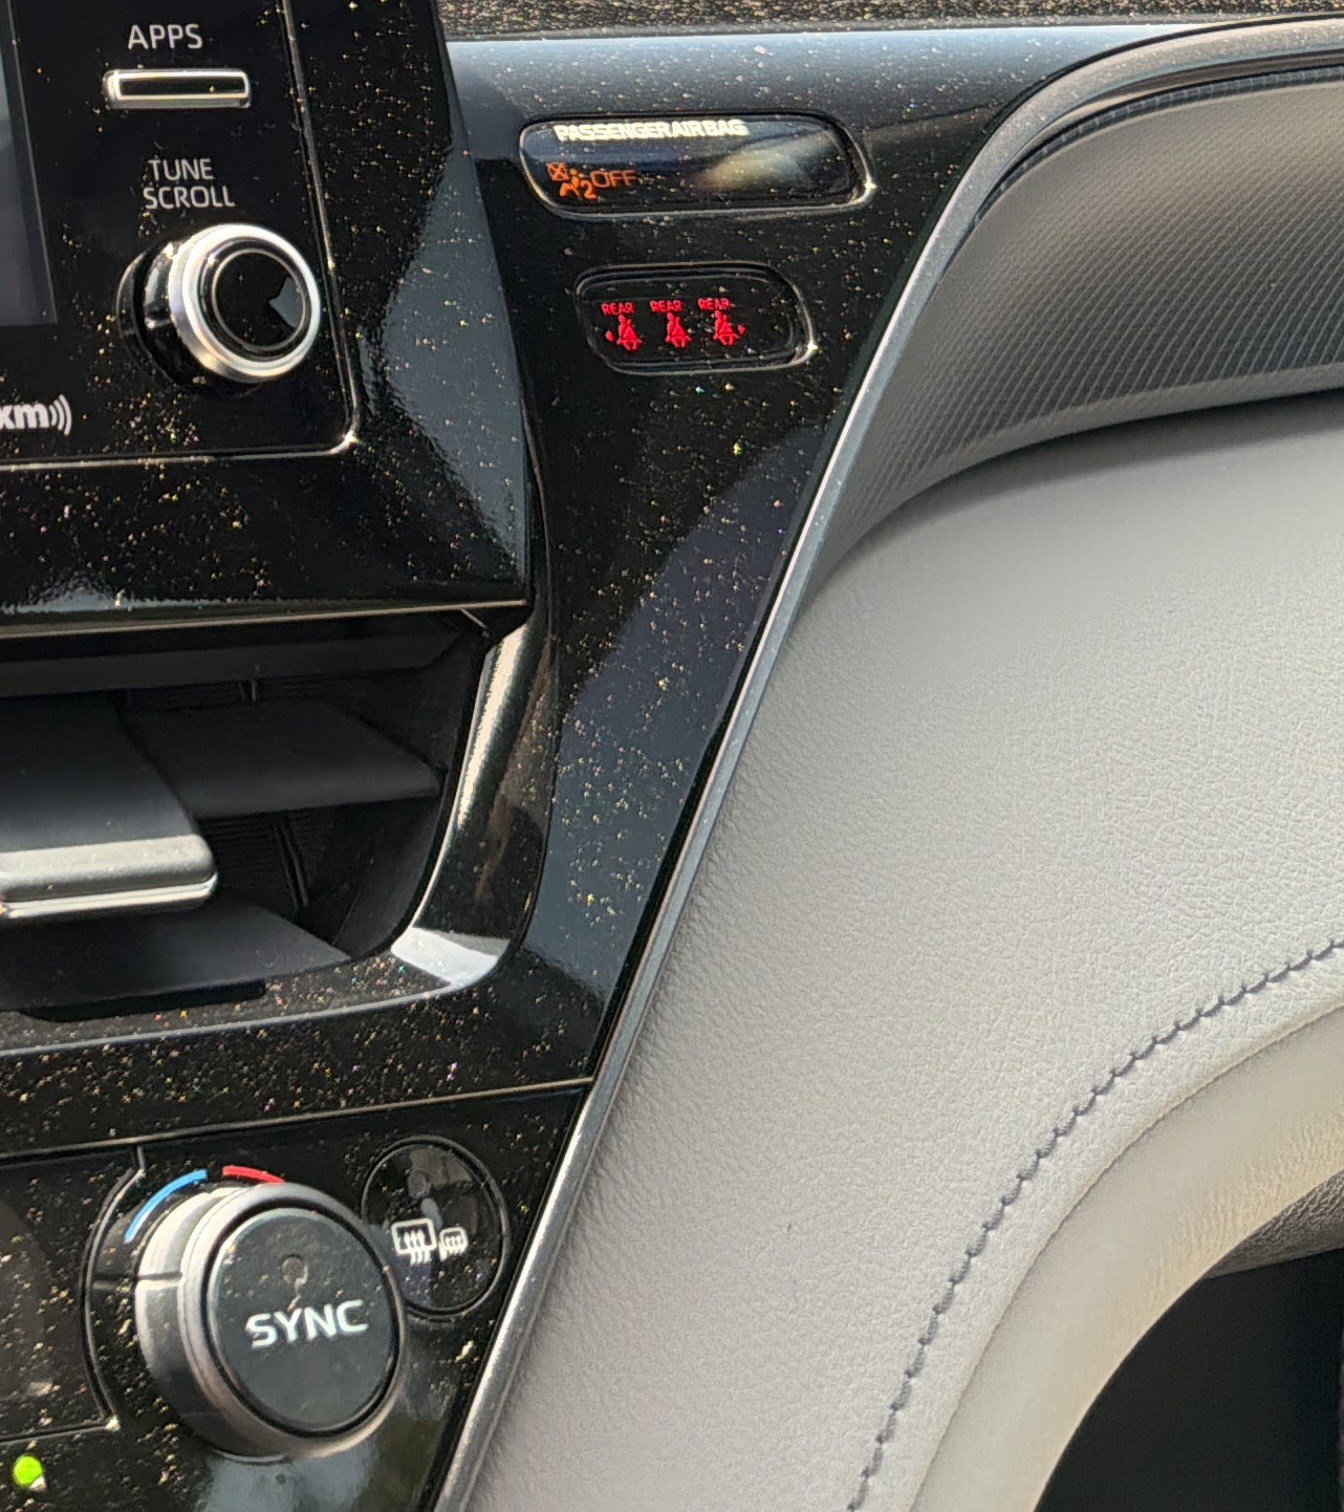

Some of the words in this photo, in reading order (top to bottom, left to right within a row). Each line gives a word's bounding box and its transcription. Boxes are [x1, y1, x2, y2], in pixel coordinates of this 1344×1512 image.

[127, 24, 203, 50] APPS
[553, 122, 671, 142] PASSENGER
[671, 120, 701, 137] AIR
[706, 119, 750, 136] BAG
[148, 158, 215, 182] TUNE
[589, 170, 639, 188] OFF
[142, 186, 236, 209] SCROLL
[601, 301, 634, 316] REAR
[650, 299, 682, 313] REAR
[698, 297, 730, 311] REAR
[244, 1299, 369, 1349] SYNC
